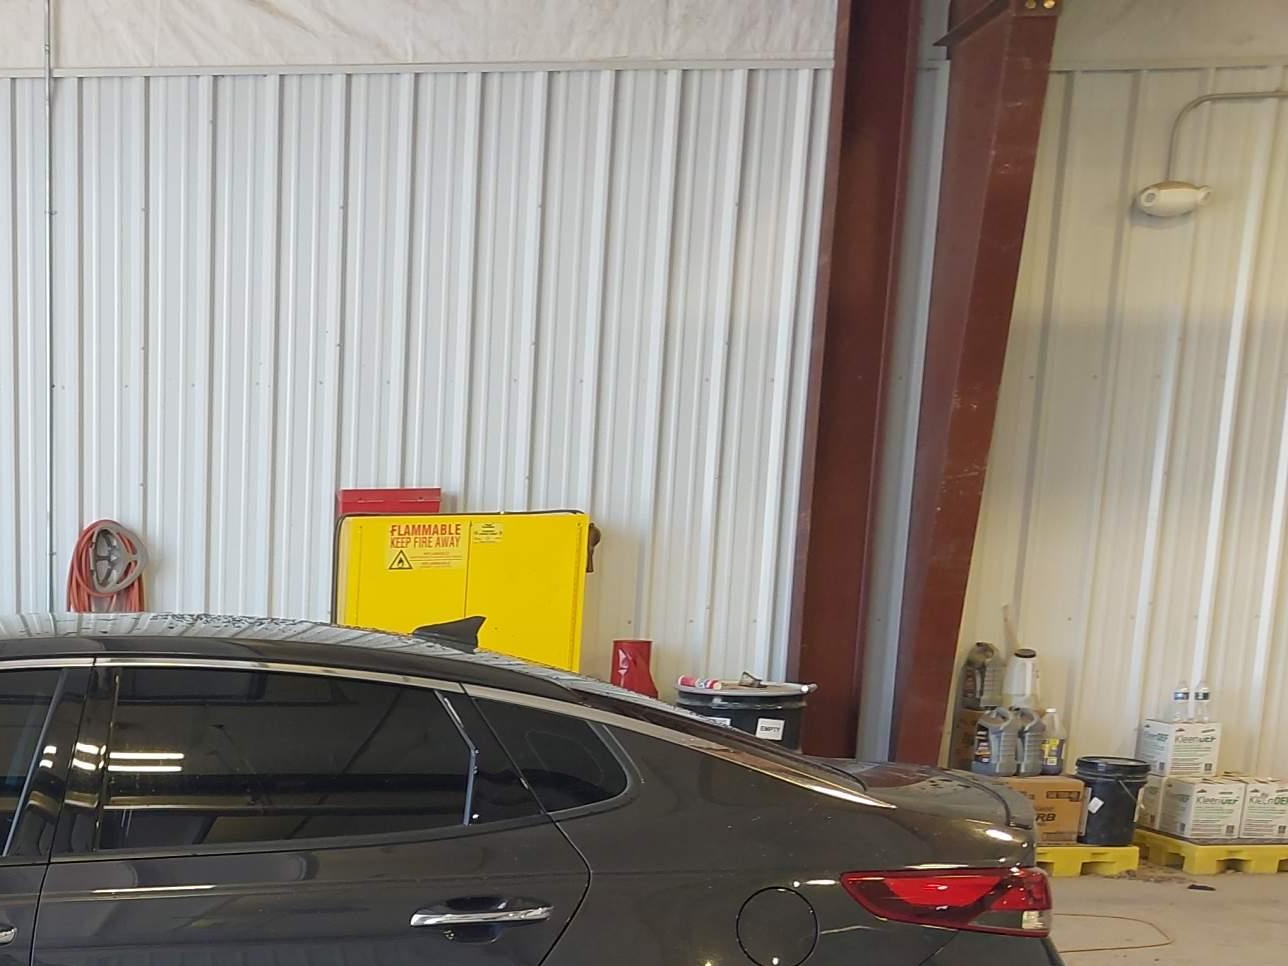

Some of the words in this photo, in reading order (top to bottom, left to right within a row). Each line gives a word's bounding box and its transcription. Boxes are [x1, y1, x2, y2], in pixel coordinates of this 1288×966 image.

[391, 524, 461, 536] FLAMMABLE
[391, 537, 411, 548] KEEP
[414, 536, 433, 548] FIRE
[435, 536, 461, 548] AWAY
